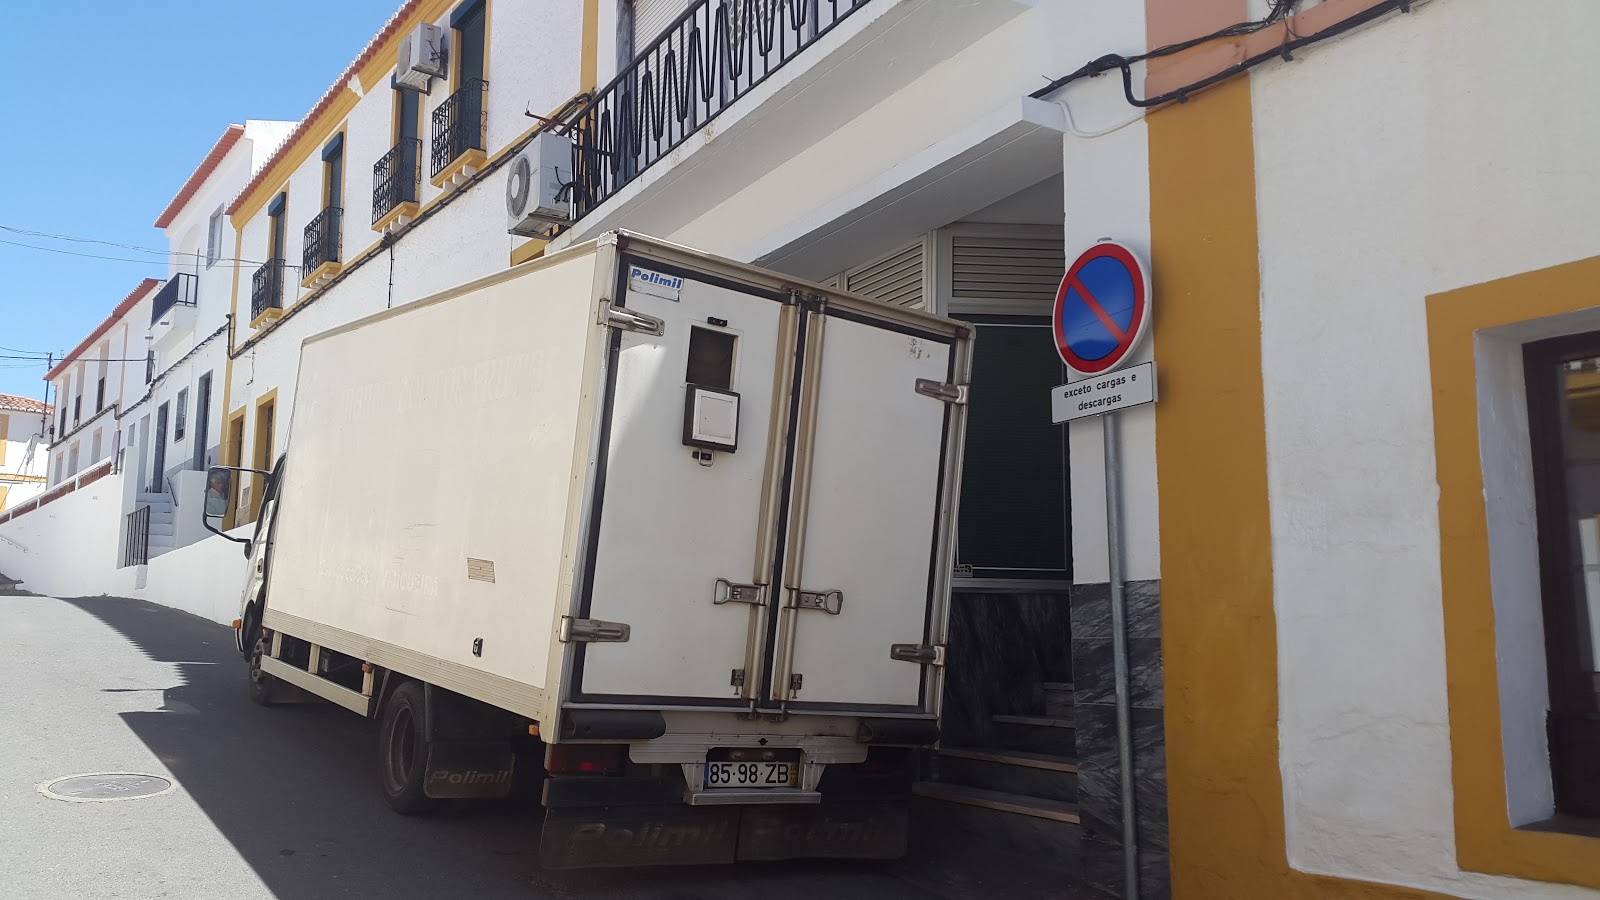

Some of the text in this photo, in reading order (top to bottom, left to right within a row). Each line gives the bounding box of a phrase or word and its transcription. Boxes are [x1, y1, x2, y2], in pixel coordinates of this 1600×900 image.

[631, 268, 682, 289] Polimil
[1064, 373, 1137, 399] exceto cargas e
[1078, 394, 1122, 411] descargas
[429, 770, 509, 784] Polimil
